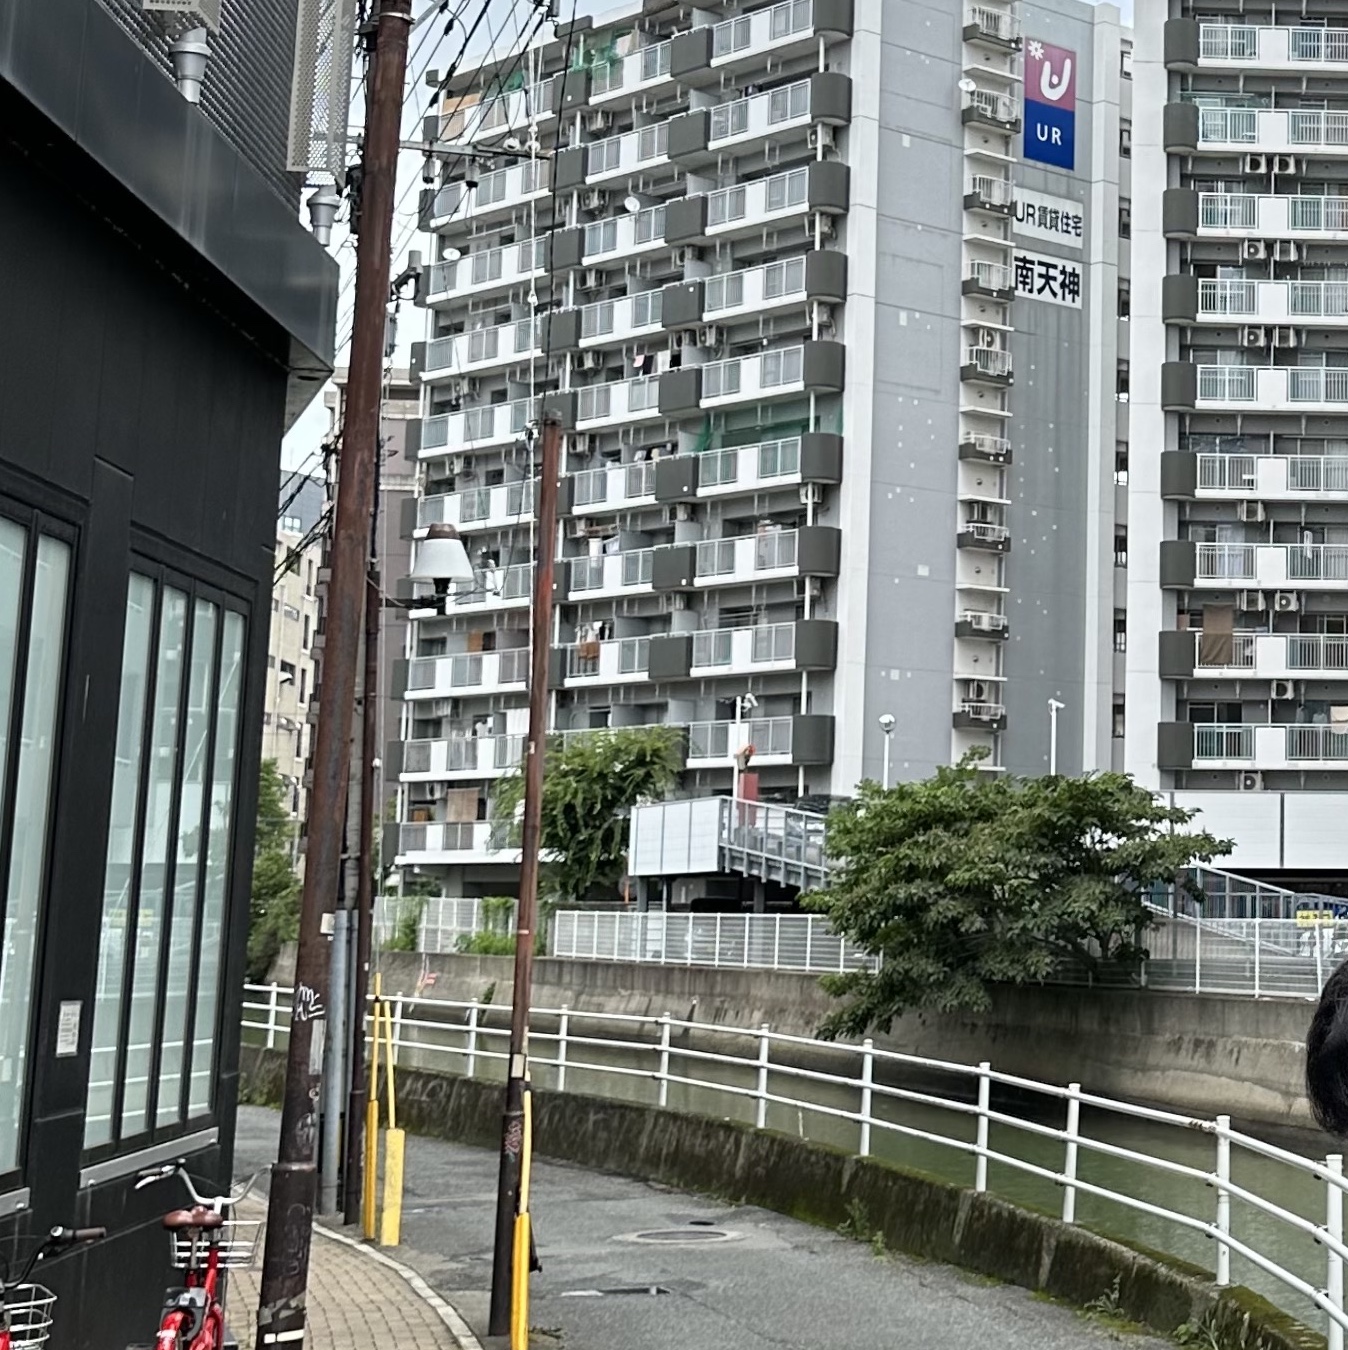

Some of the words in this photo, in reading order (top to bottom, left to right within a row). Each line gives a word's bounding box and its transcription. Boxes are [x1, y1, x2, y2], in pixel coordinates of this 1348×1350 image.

[1036, 122, 1062, 146] UR
[1014, 200, 1083, 237] UR賃貸住宅
[1013, 255, 1081, 304] 南天神
